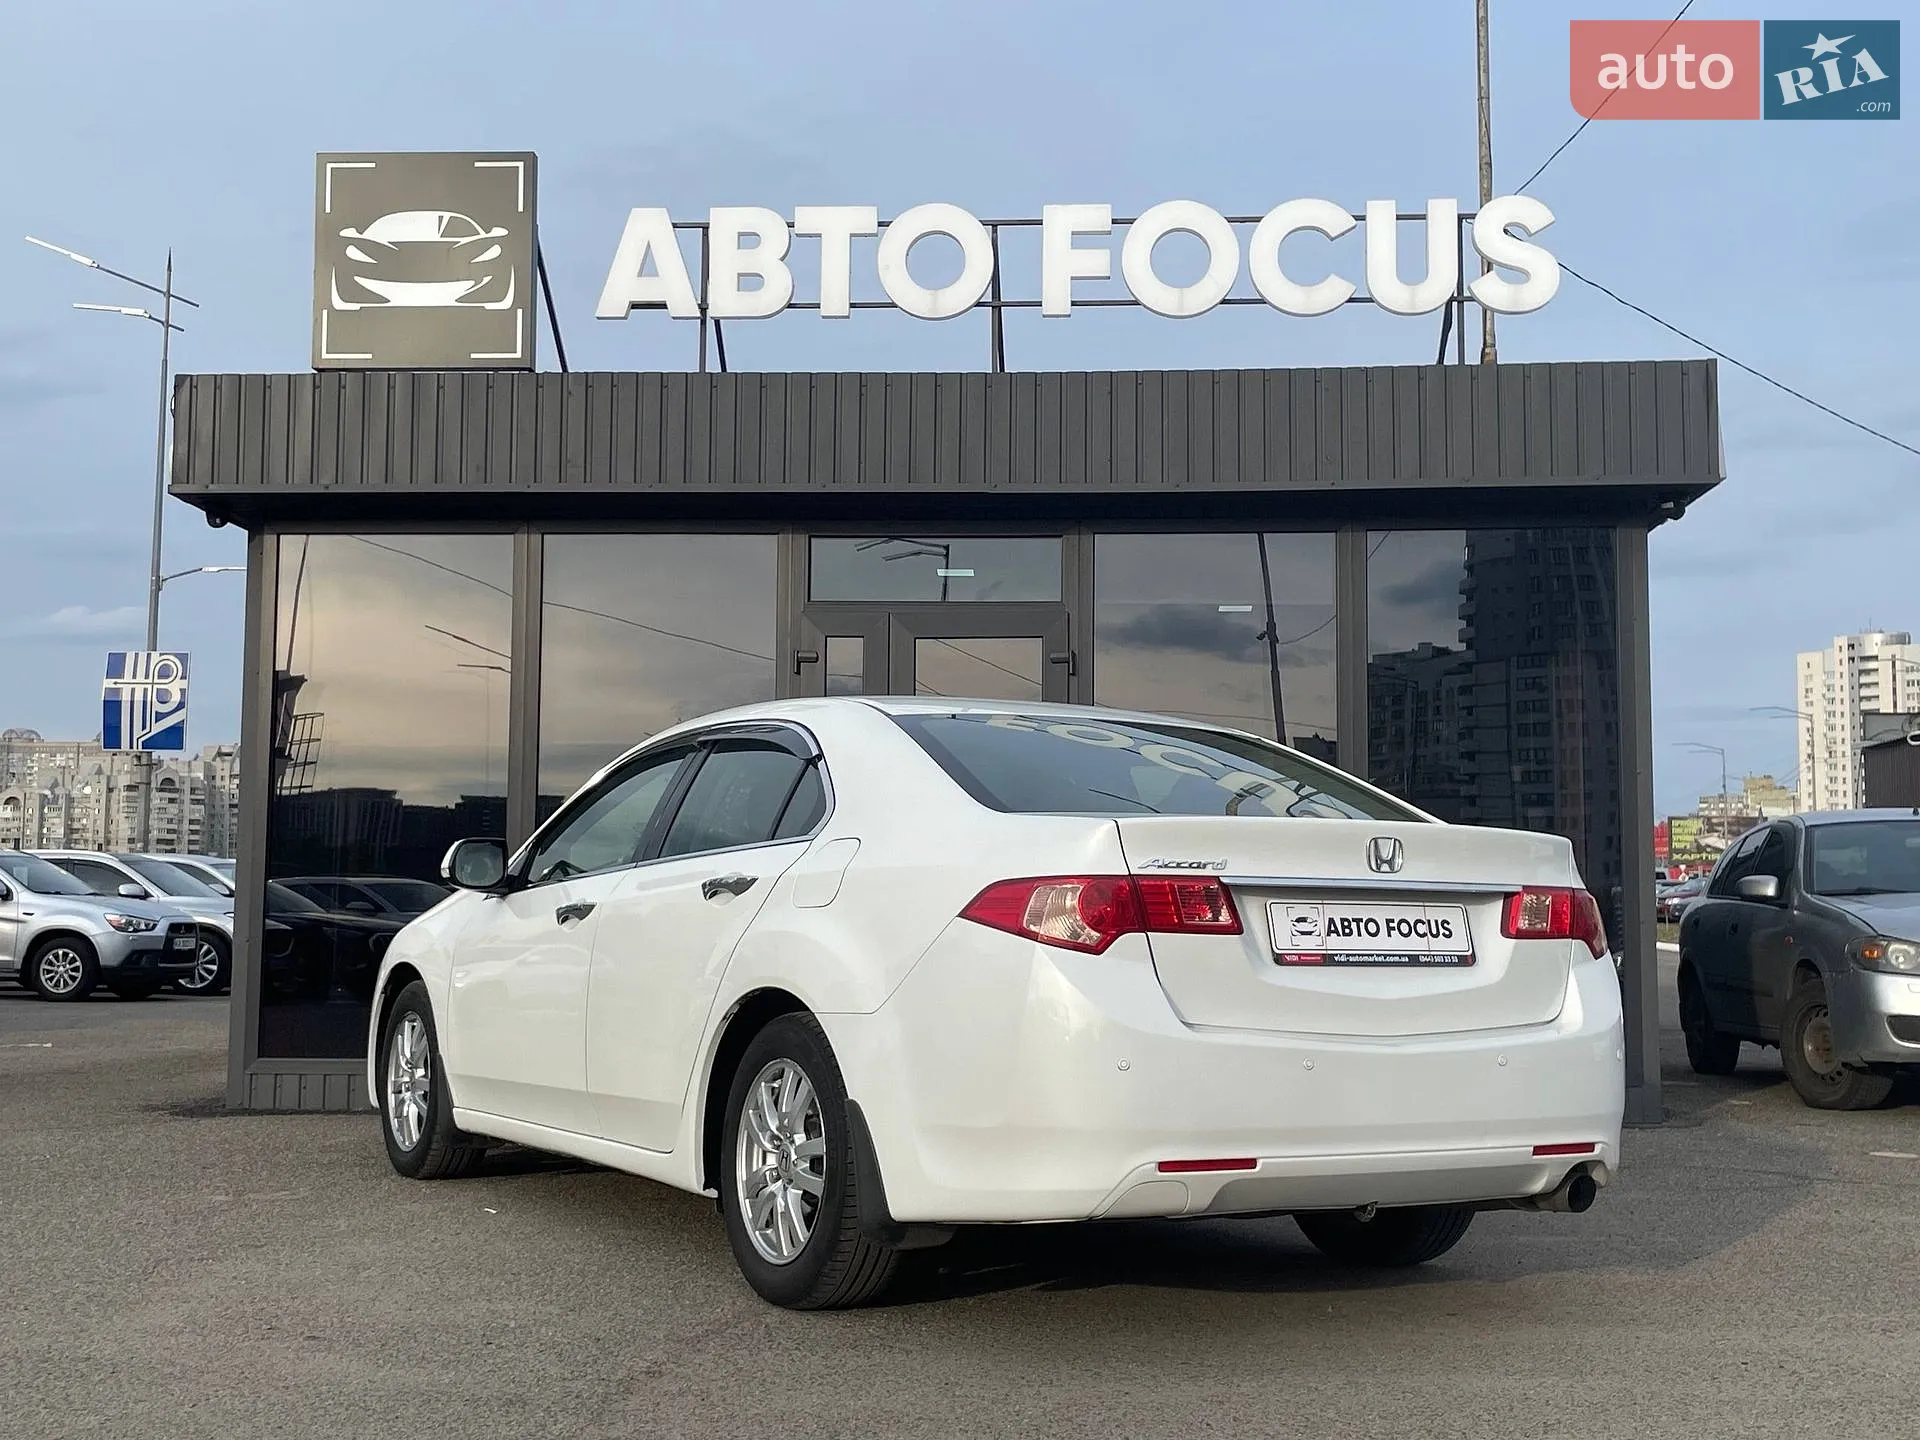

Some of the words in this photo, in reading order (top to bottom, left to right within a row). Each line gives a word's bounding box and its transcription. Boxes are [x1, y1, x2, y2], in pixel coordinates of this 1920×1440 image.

[596, 202, 995, 321] АВТО
[1042, 197, 1561, 317] FOCUS
[1138, 857, 1228, 871] Accord
[1326, 917, 1381, 938] АВТО
[1386, 918, 1453, 939] FOCUS
